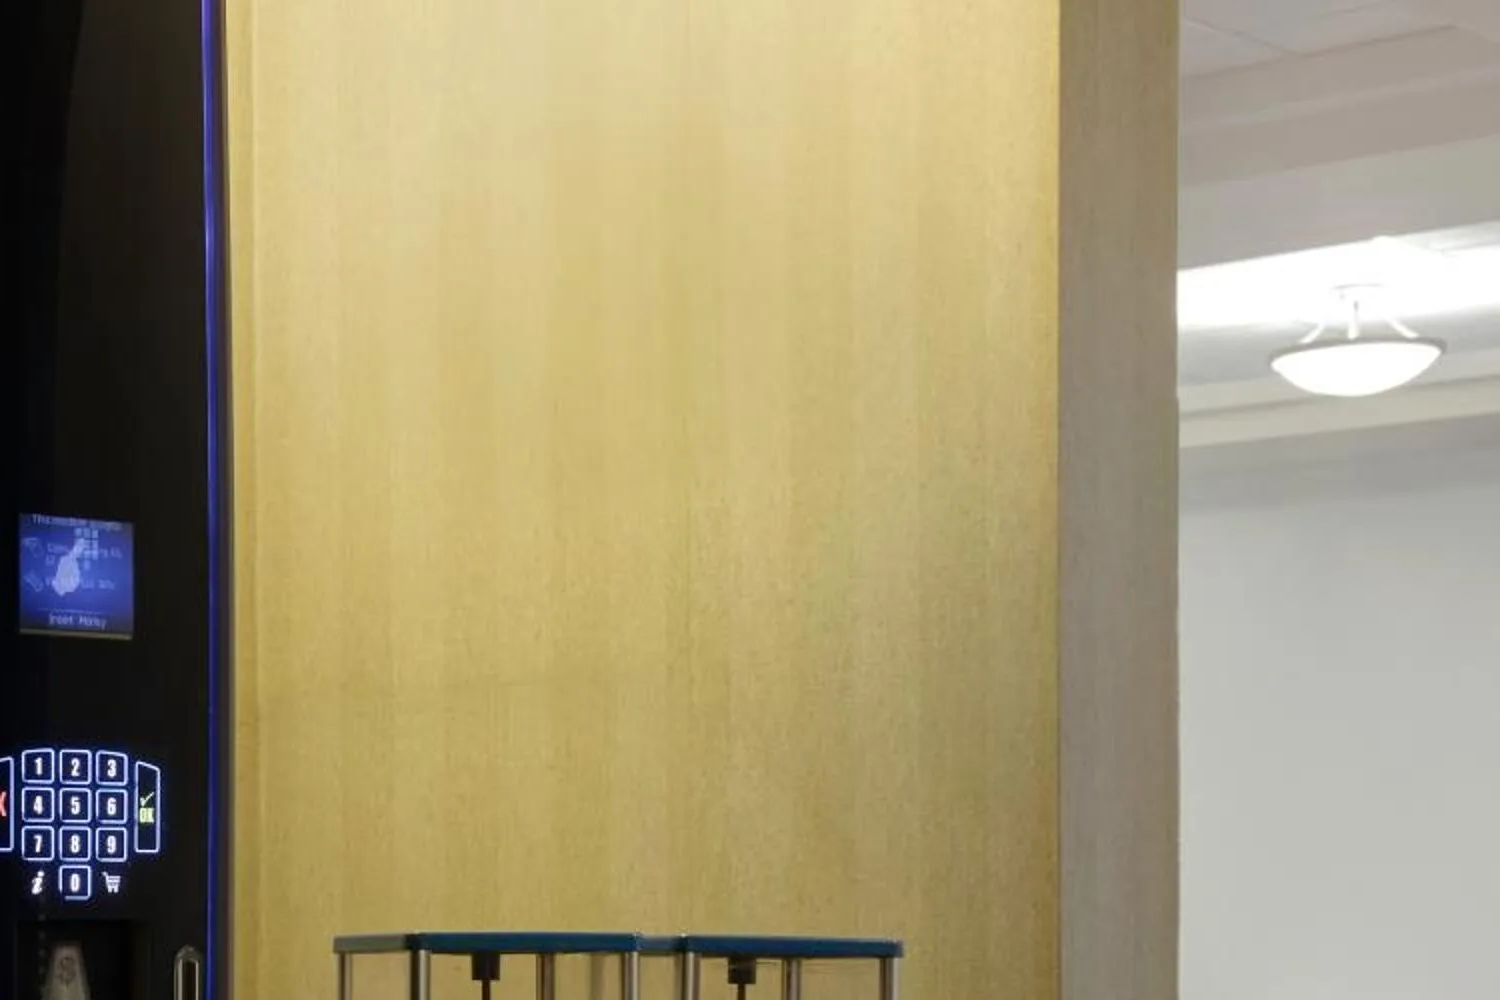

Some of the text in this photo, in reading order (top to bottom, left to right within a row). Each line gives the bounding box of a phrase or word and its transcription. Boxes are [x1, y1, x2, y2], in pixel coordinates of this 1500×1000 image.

[34, 757, 117, 779] 1 2 3
[33, 796, 44, 816] 4
[70, 797, 81, 816] 5
[106, 797, 117, 816] 6
[139, 806, 156, 825] OK
[33, 834, 117, 855] 7 8 9
[69, 872, 81, 893] 0
